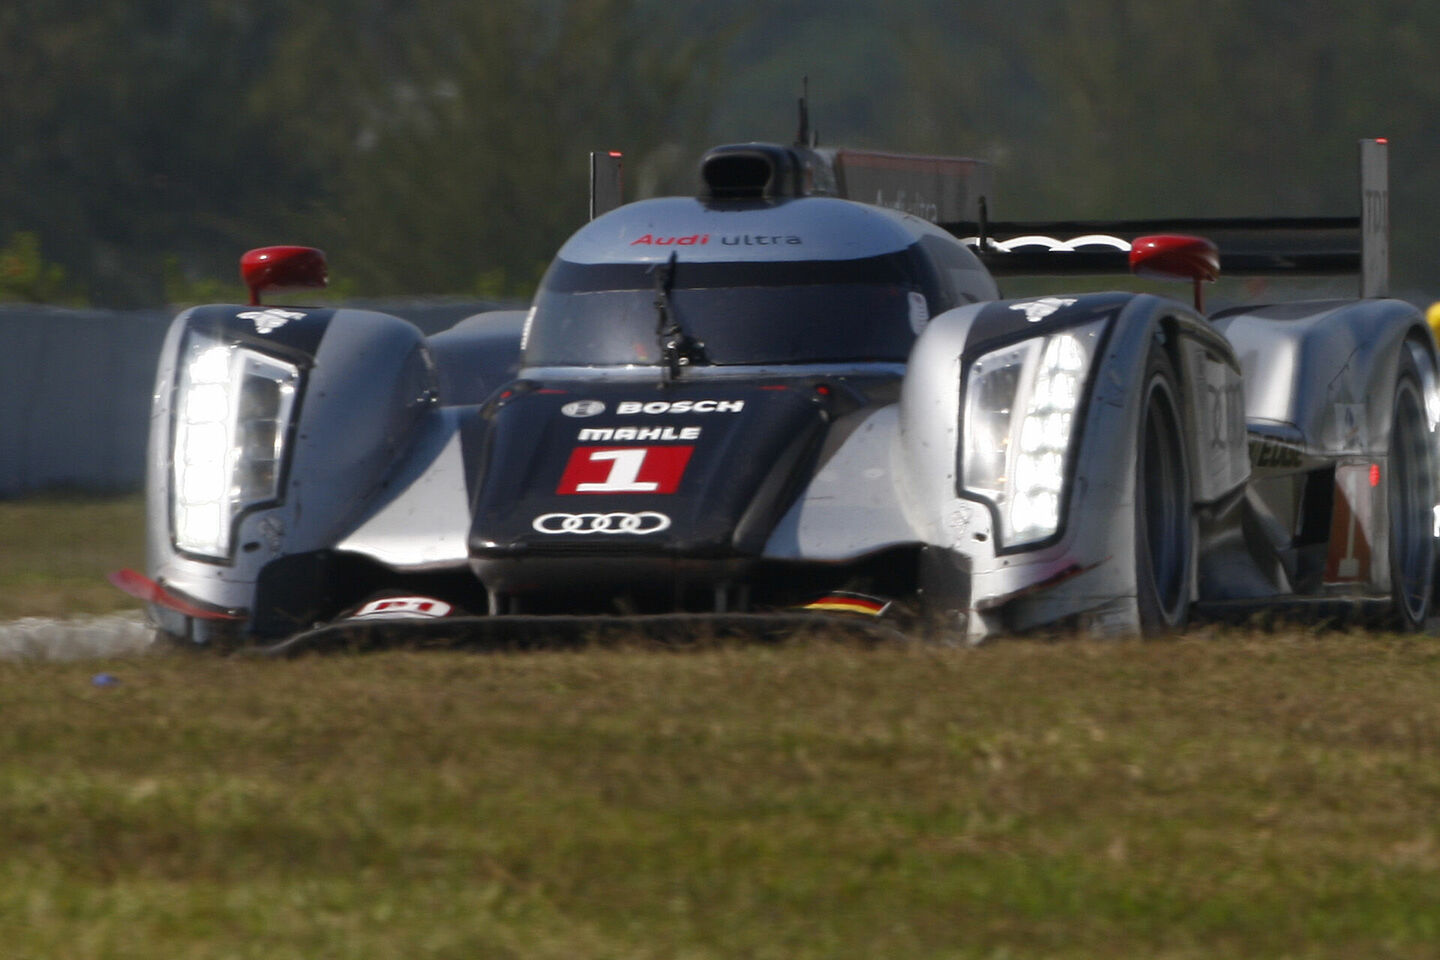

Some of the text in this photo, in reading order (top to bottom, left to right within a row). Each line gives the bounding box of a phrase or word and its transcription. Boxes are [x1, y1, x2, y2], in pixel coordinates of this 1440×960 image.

[631, 233, 804, 246] Audi ultra
[616, 400, 745, 415] BOSCH
[578, 427, 702, 441] MAHLE
[576, 448, 659, 492] 1
